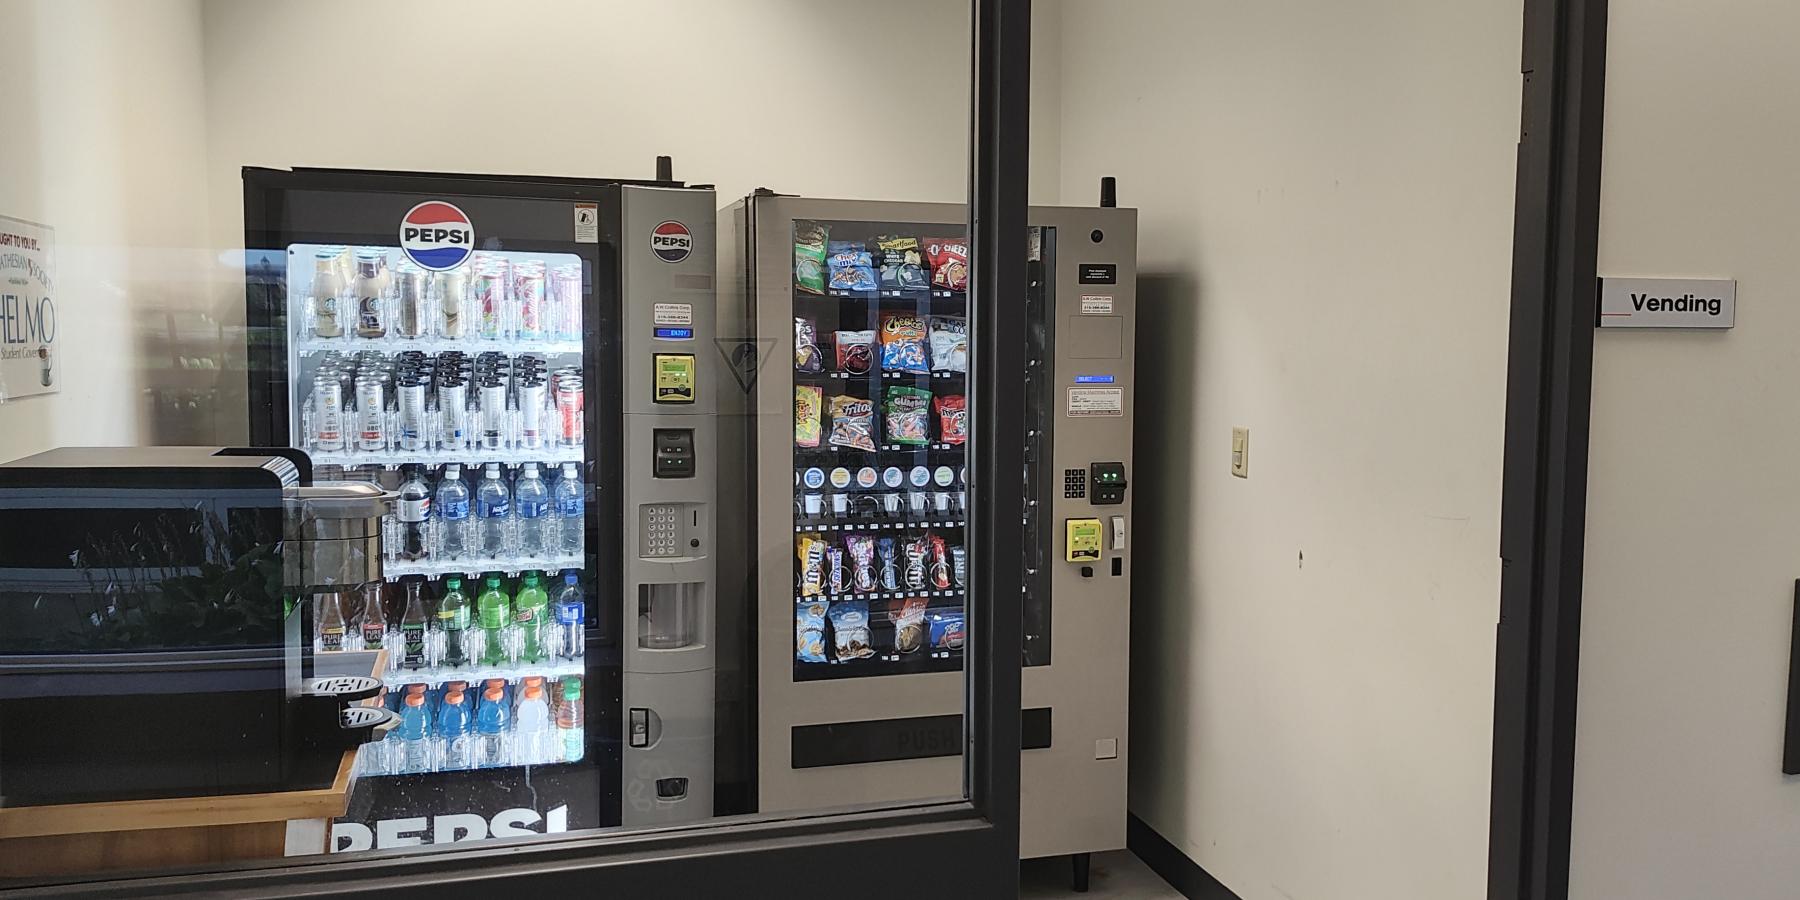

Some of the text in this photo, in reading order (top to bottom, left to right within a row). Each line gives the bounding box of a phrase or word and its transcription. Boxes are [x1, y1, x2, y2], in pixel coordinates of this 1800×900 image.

[14, 235, 20, 249] TO
[21, 236, 31, 250] YOU
[404, 227, 470, 245] PEPSI
[653, 236, 690, 248] PEPSI
[1630, 293, 1721, 316] Vending
[885, 316, 924, 333] Cheetos
[896, 727, 955, 752] PUSH
